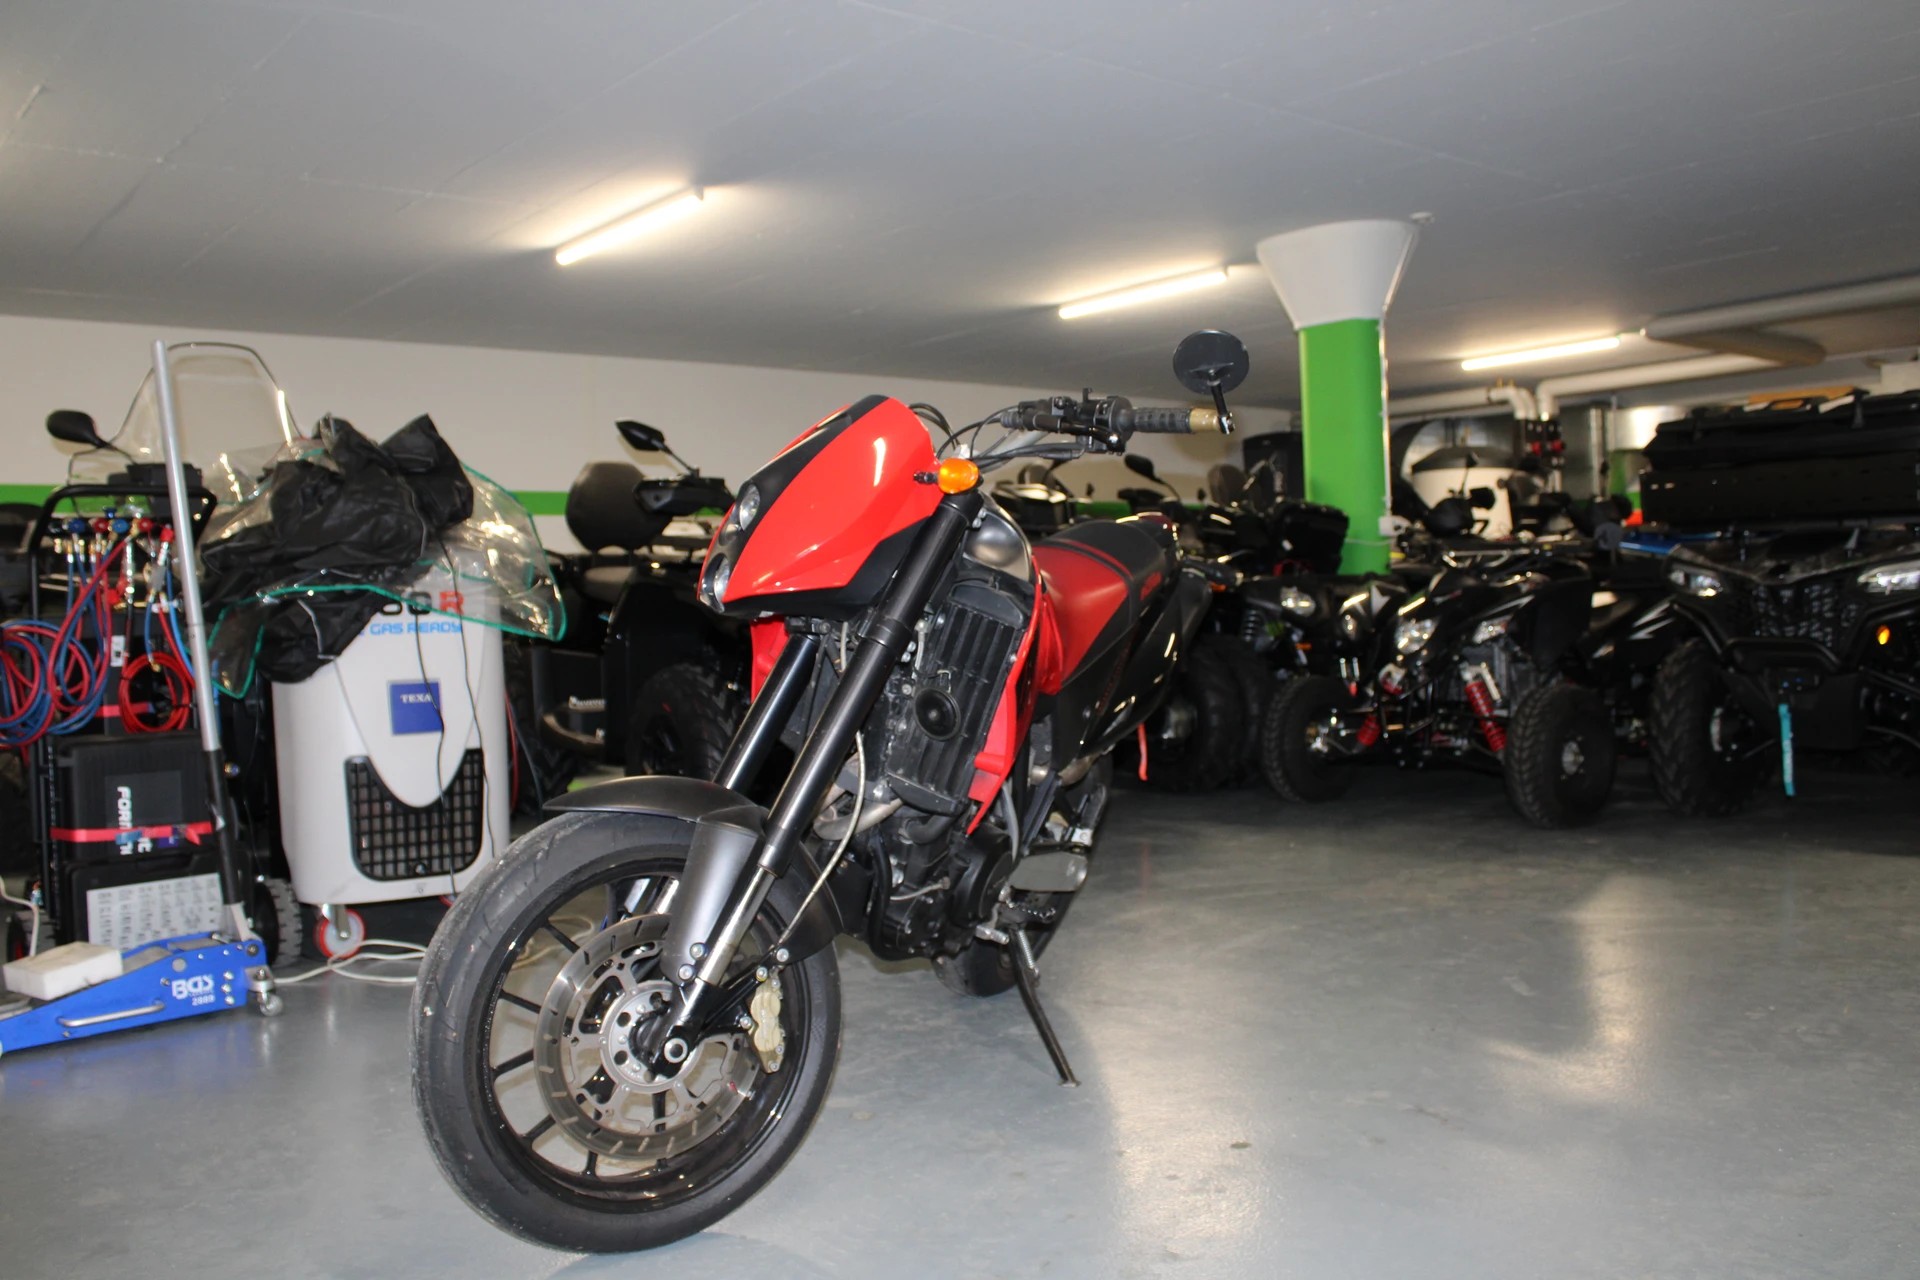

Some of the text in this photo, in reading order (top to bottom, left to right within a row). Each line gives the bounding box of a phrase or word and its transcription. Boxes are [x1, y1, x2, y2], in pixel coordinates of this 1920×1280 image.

[370, 622, 403, 636] GAS
[407, 621, 462, 634] READY
[400, 693, 432, 704] TEXA
